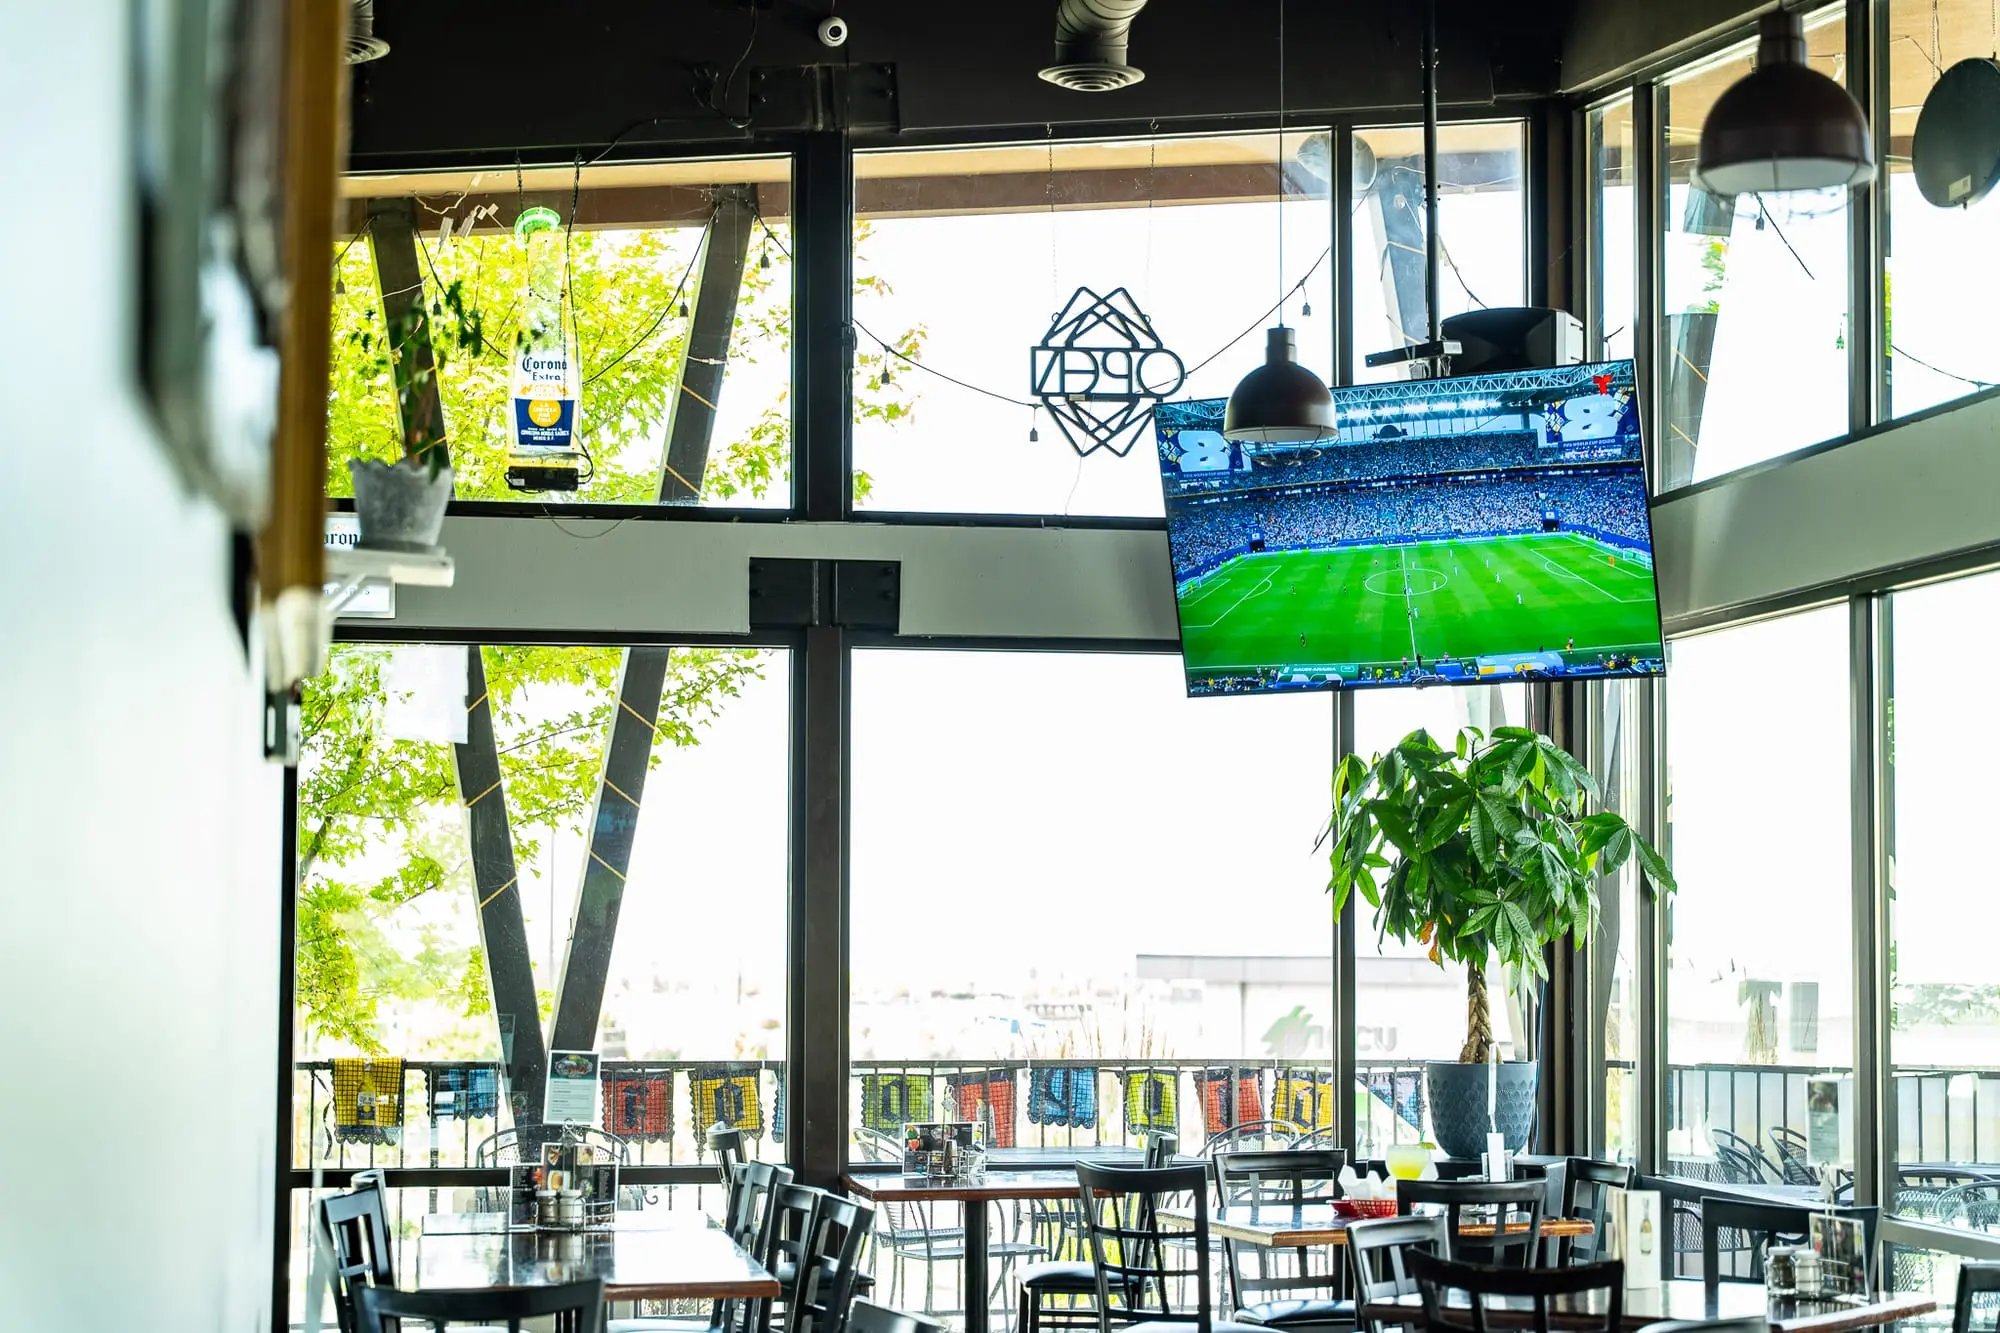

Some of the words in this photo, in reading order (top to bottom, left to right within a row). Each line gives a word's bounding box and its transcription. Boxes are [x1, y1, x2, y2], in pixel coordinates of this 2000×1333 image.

[522, 356, 567, 373] Corona
[532, 371, 561, 381] Extra
[323, 533, 358, 545] oron
